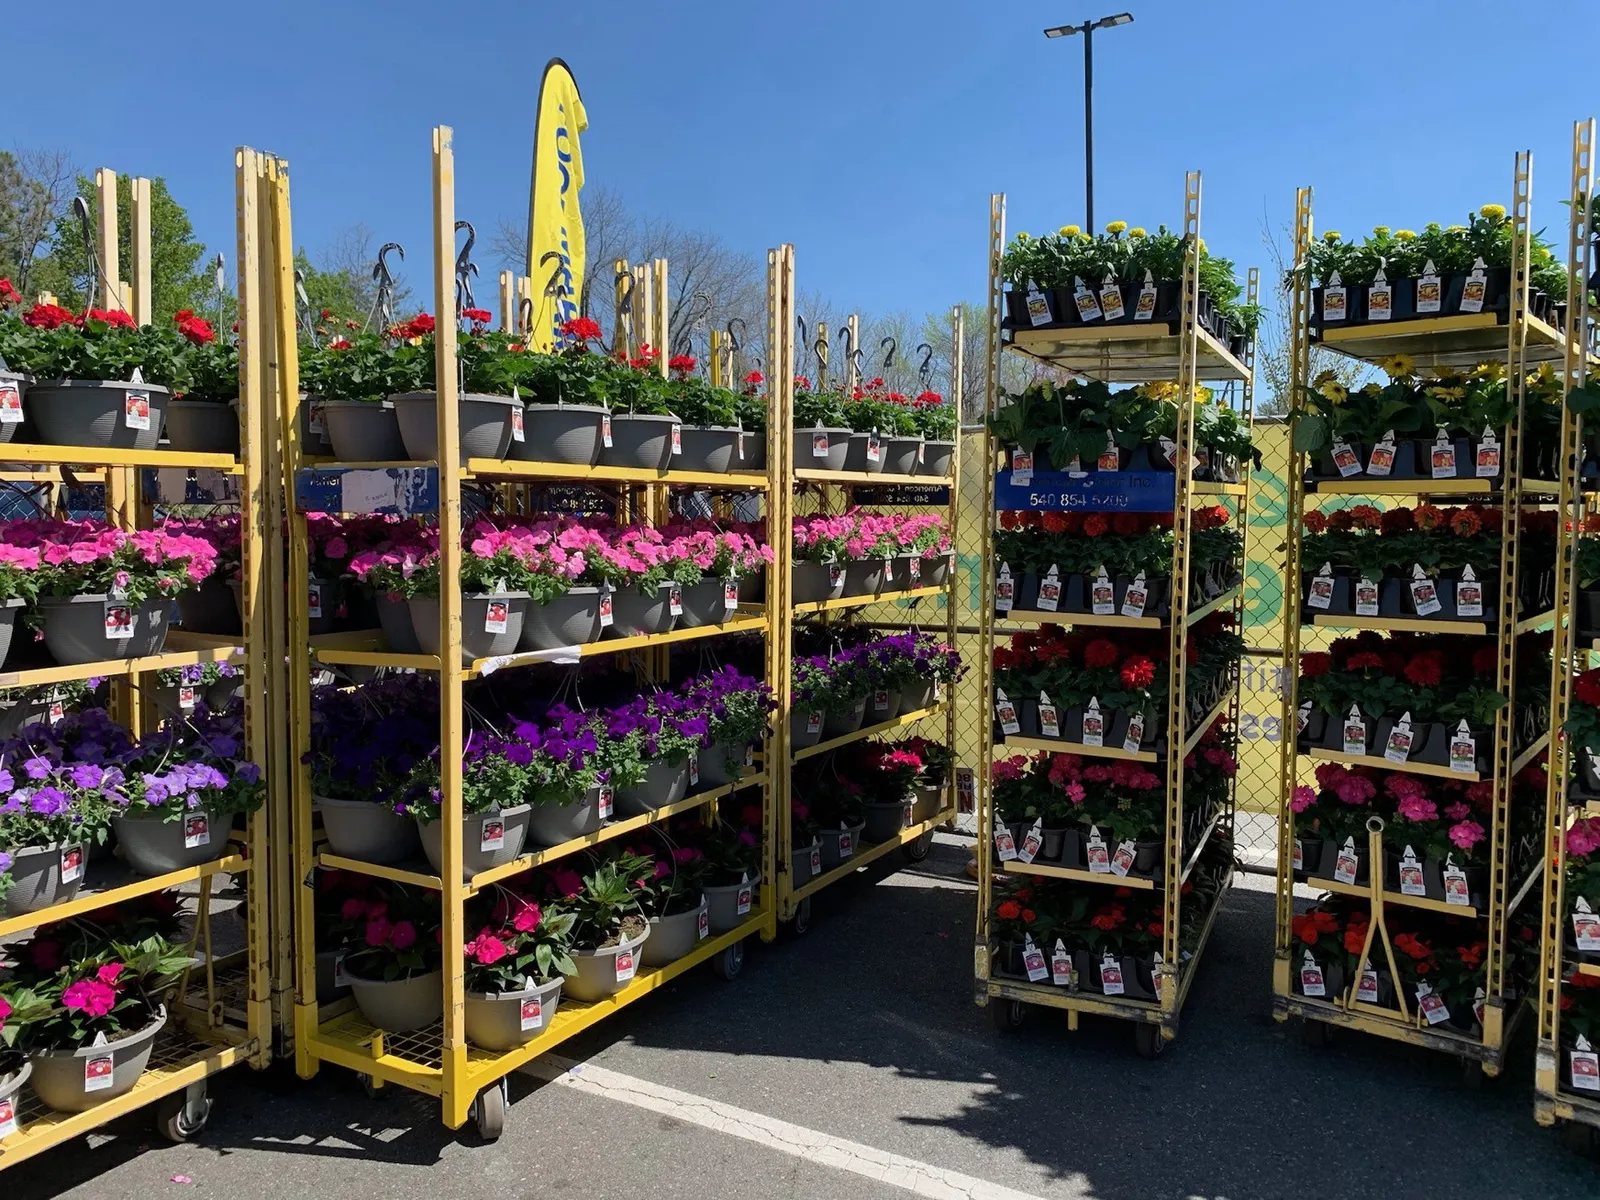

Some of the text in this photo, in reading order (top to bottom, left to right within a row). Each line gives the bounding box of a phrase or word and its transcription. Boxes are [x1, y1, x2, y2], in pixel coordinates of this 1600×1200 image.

[1129, 475, 1155, 488] Inc.
[1029, 492, 1056, 507] 540
[1060, 492, 1088, 507] 854
